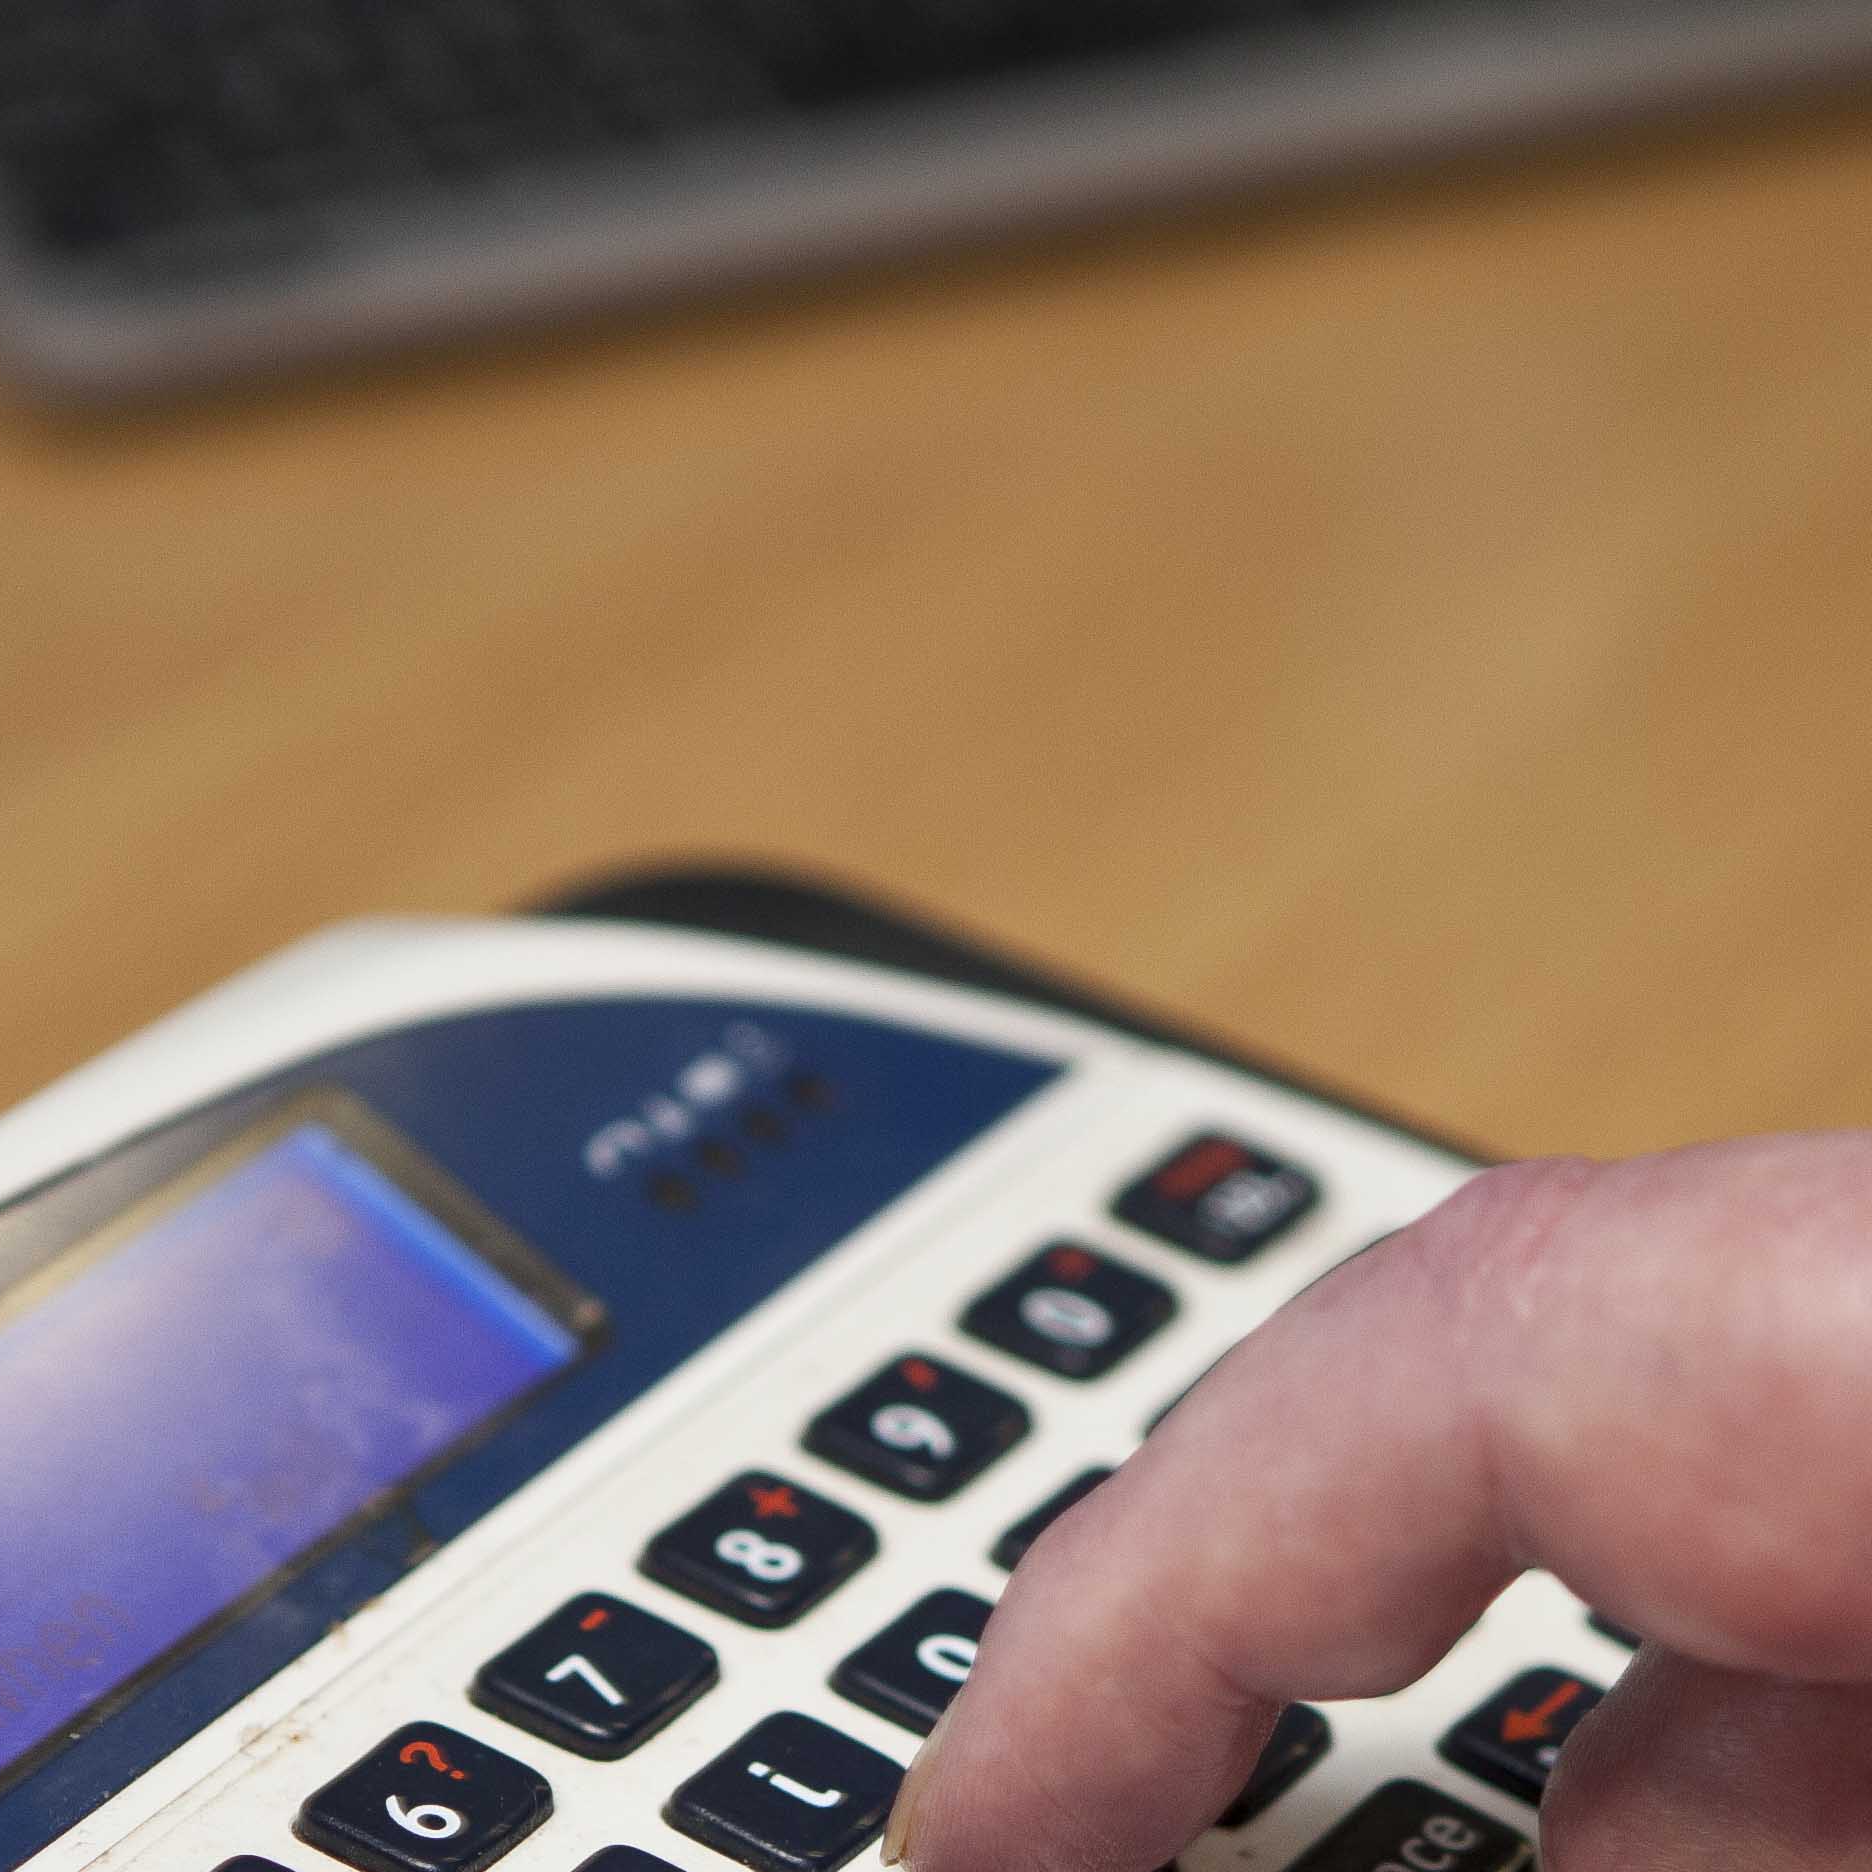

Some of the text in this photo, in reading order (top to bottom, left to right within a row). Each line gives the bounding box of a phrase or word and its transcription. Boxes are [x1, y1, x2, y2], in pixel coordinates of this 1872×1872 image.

[1023, 1290, 1111, 1345] 0
[873, 1405, 954, 1455] 9
[716, 1530, 803, 1581] 8
[546, 1655, 624, 1705] 7
[385, 1739, 468, 1839] 6 ?
[748, 1762, 842, 1808] i
